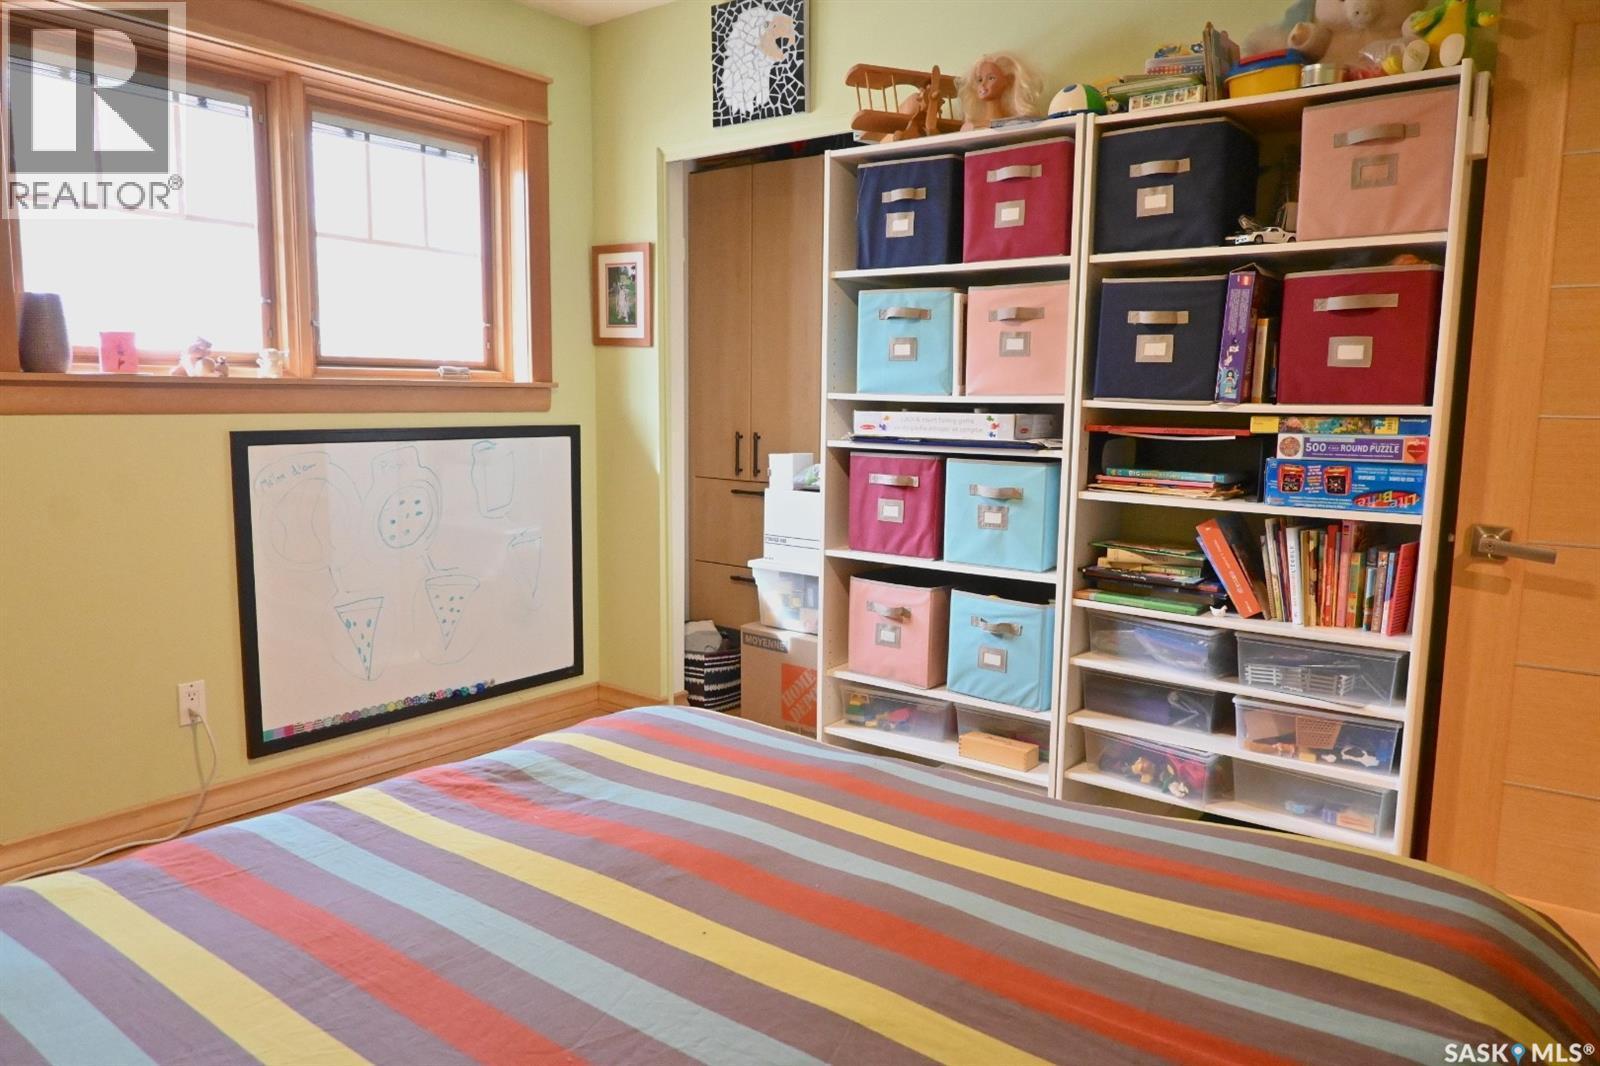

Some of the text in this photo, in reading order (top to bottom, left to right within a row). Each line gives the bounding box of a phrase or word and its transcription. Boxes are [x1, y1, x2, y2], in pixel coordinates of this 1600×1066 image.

[1305, 442, 1400, 454] 500 ROUND PUZZLE
[782, 668, 817, 708] HOME
